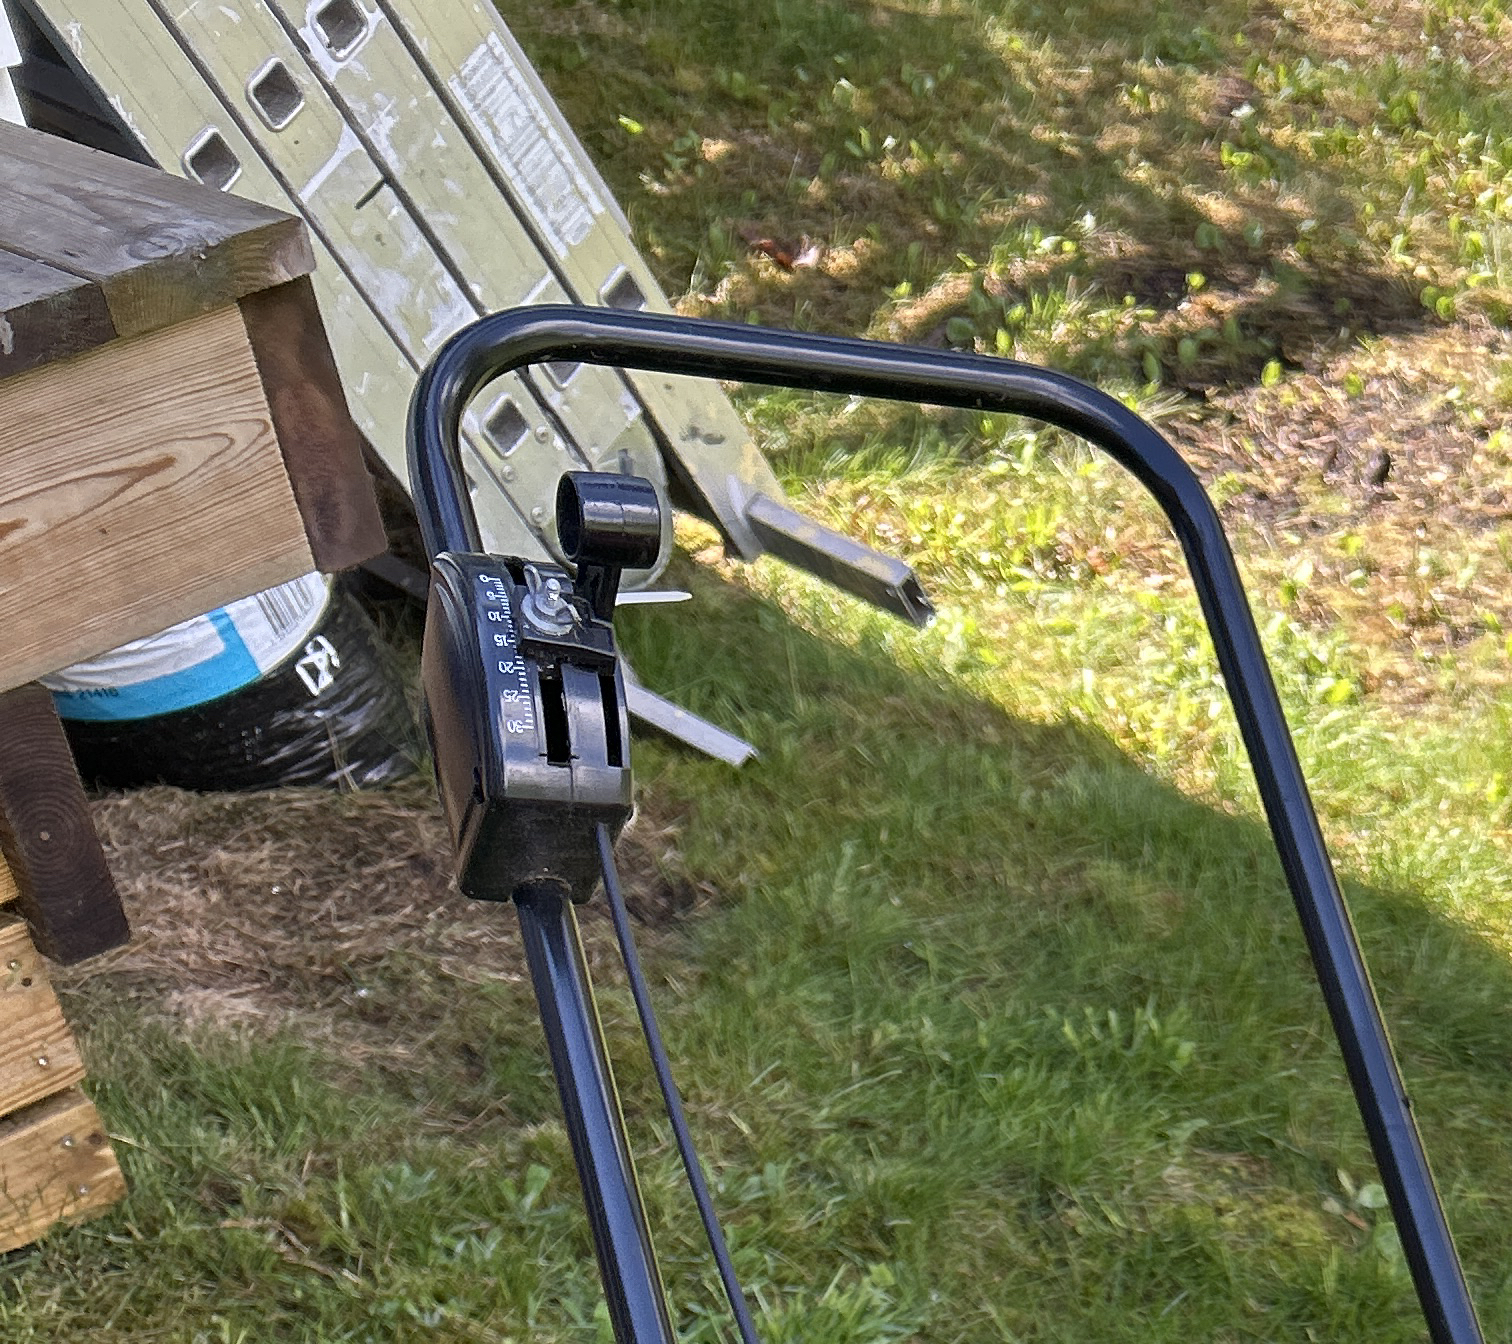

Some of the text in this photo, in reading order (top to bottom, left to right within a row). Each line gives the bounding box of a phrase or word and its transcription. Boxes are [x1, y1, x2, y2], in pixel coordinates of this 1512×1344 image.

[479, 574, 489, 583] 0
[488, 611, 502, 622] 10
[493, 634, 509, 646] 15
[498, 661, 514, 674] 20
[503, 689, 519, 702] 25
[507, 720, 523, 733] 30
